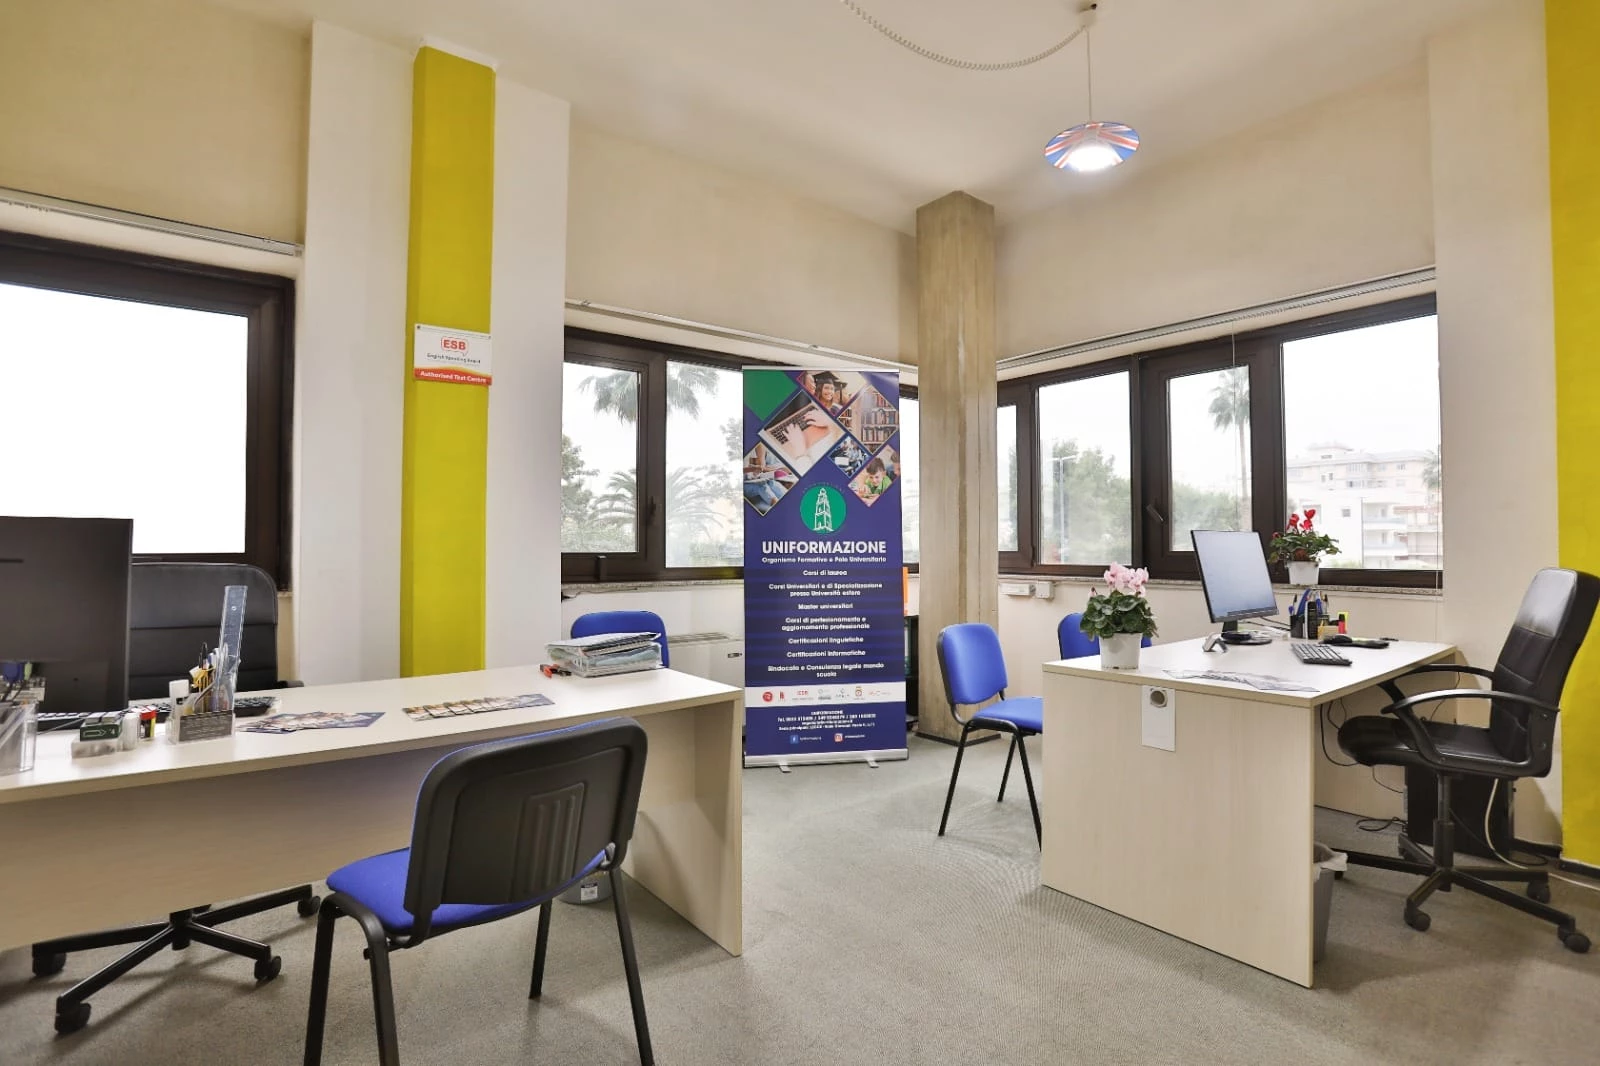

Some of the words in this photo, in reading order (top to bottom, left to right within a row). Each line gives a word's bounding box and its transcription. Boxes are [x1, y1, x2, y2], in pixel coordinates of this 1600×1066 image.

[443, 339, 466, 350] ESB
[762, 541, 887, 554] UNIFORMAZIONE
[762, 557, 796, 565] Organismo
[811, 589, 841, 597] Università
[786, 650, 827, 658] Certificazioni
